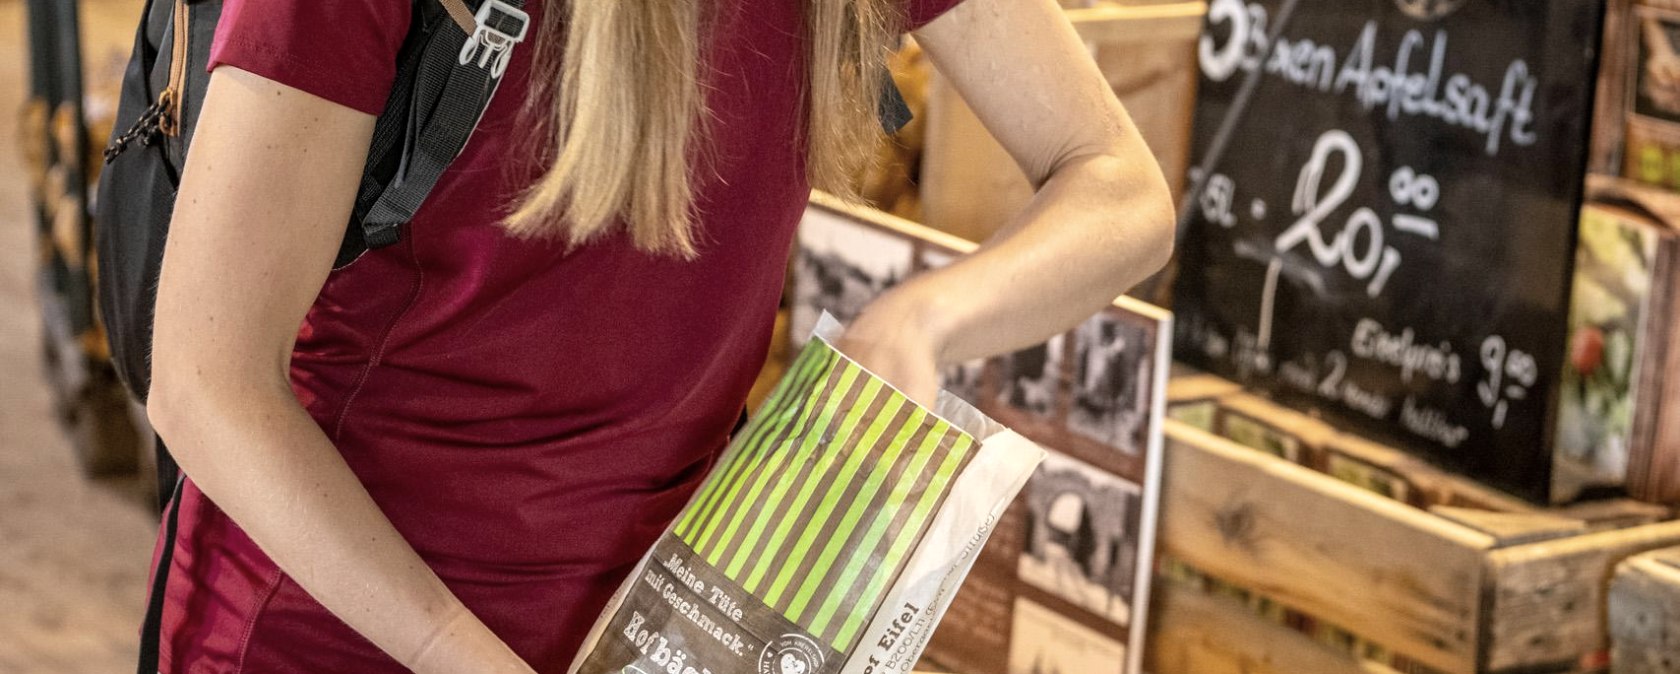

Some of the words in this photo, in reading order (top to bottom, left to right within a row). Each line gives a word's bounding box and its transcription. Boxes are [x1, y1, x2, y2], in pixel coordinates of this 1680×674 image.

[1242, 3, 1336, 92] Bxen
[1334, 20, 1538, 156] Apfelsaft
[644, 569, 666, 592] mit
[708, 585, 743, 621] Tüte
[623, 609, 712, 674] Hofbä
[877, 602, 920, 651] Eifel
